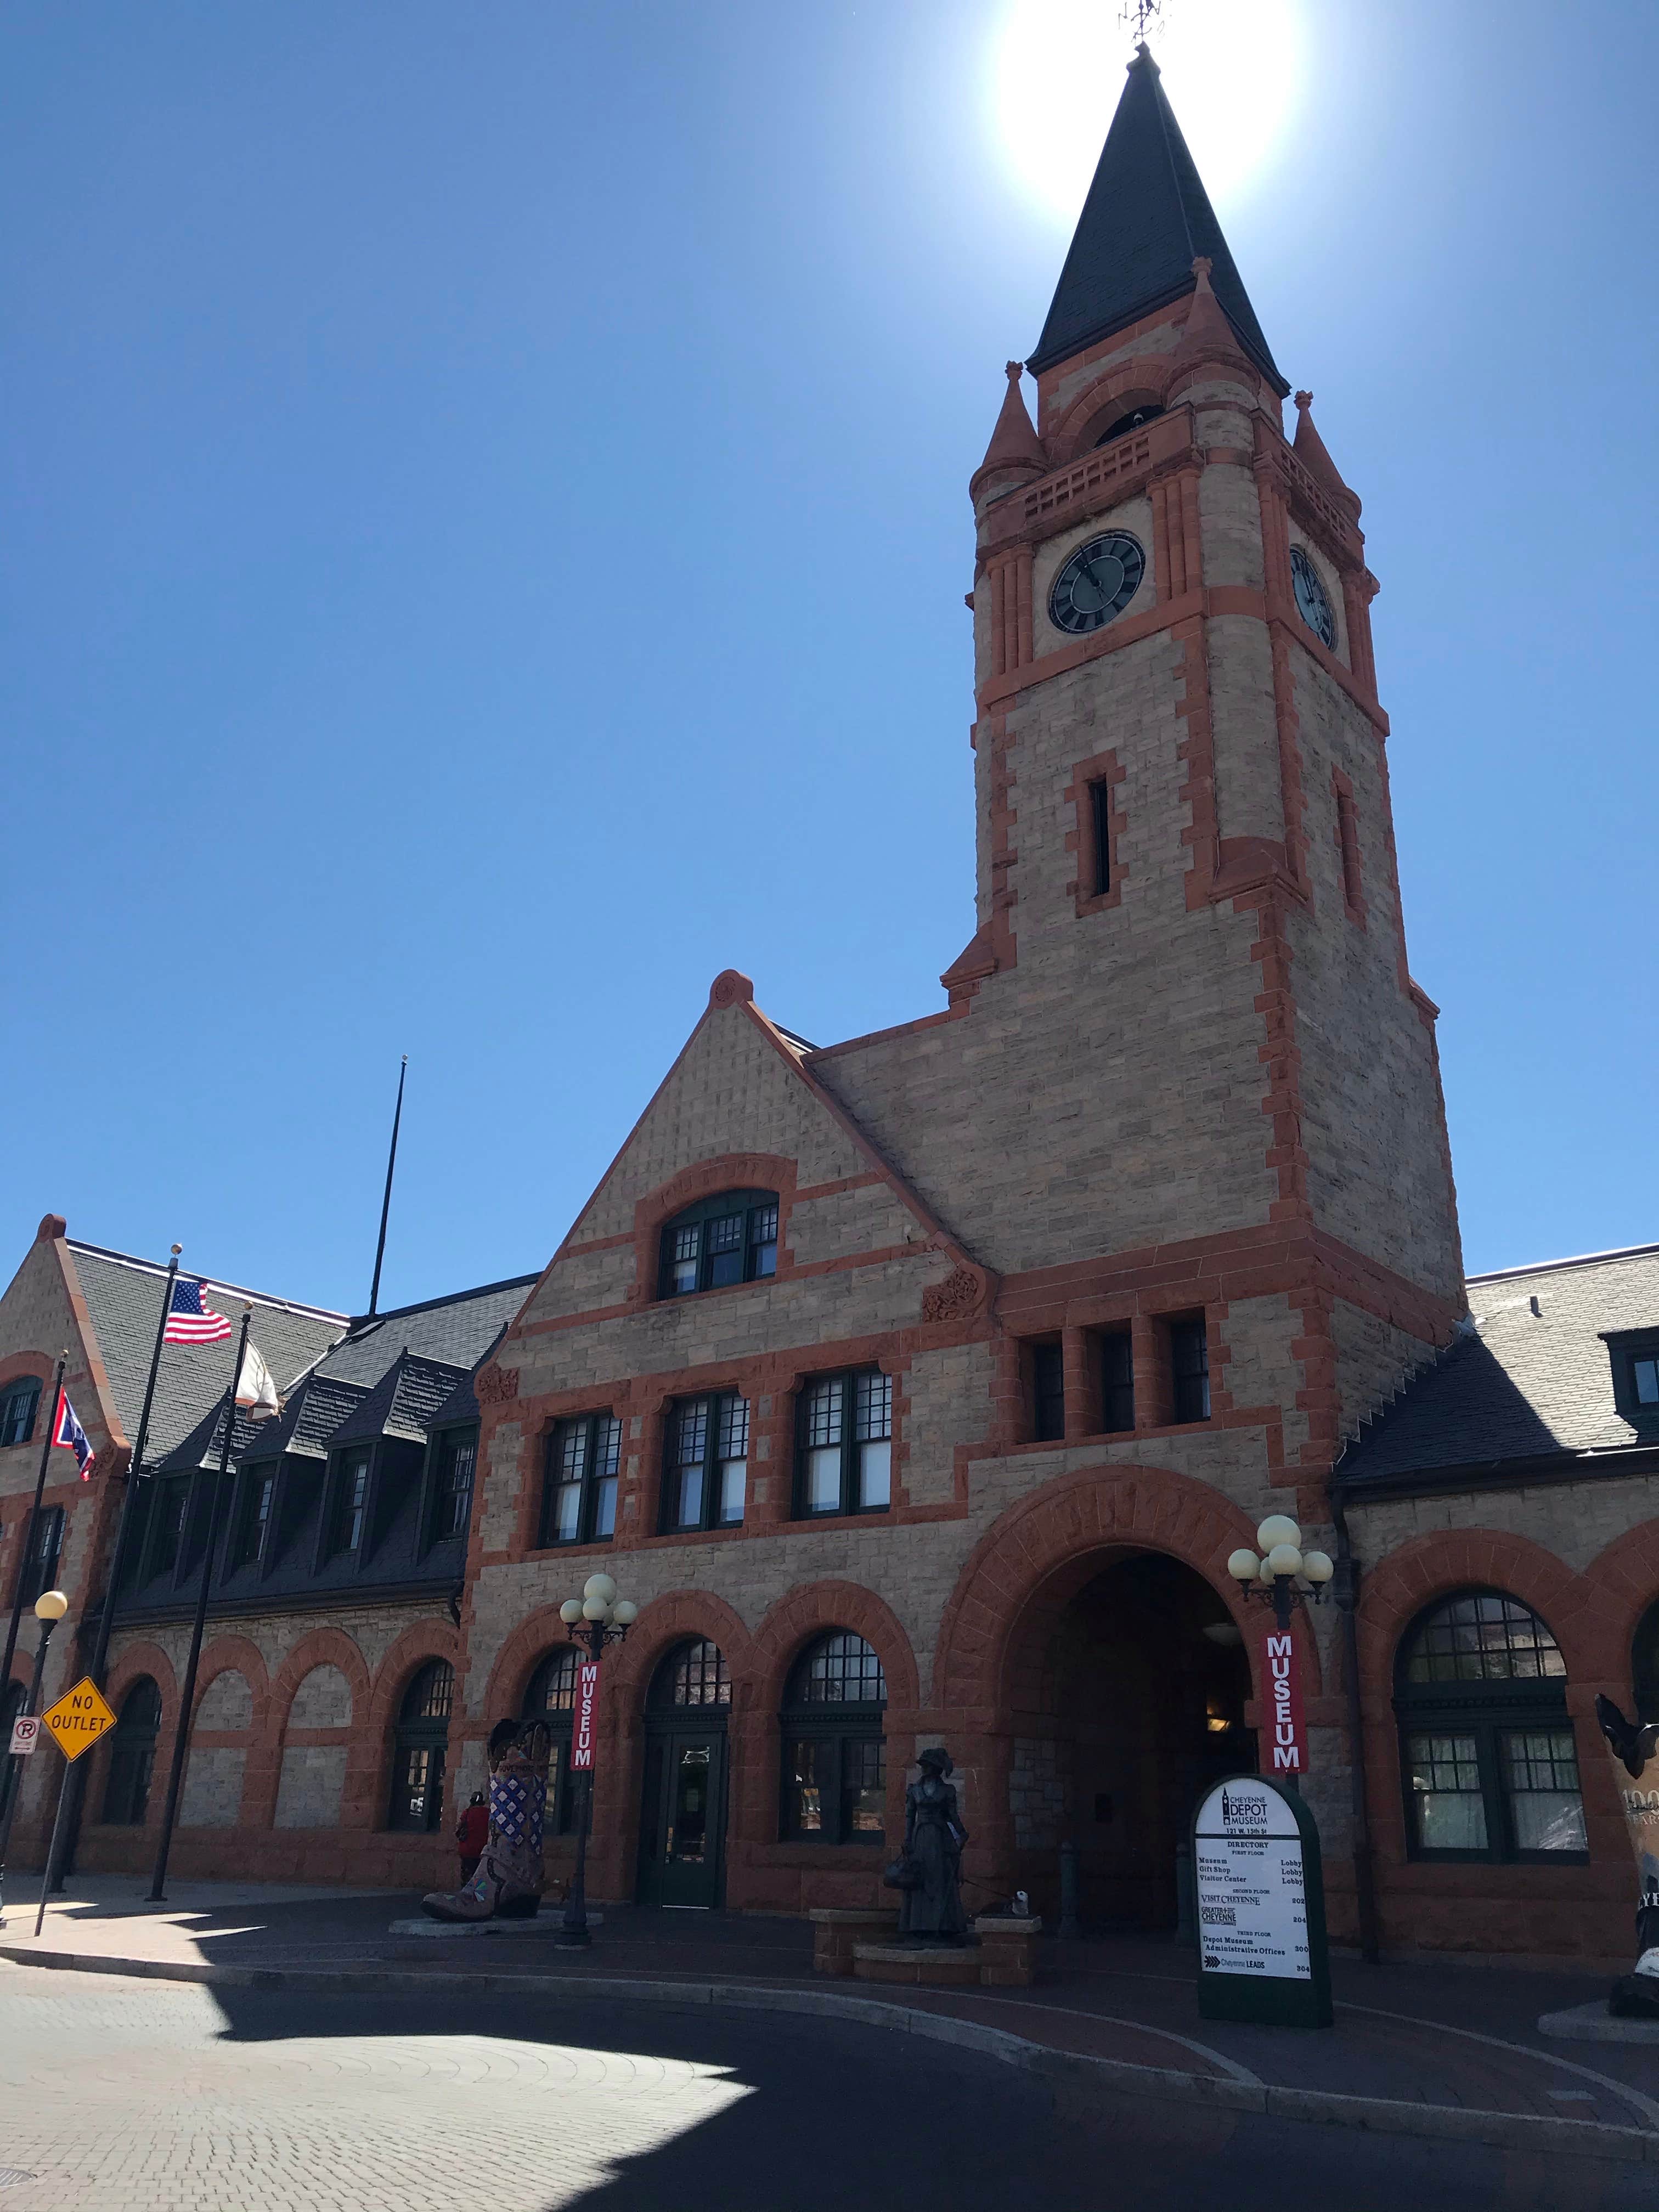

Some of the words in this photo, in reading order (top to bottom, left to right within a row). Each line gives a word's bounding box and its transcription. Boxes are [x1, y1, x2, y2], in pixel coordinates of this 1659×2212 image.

[72, 1695, 93, 1709] NO
[1267, 1635, 1300, 1768] MUSEUM
[575, 1666, 597, 1766] MUSEUM
[52, 1715, 106, 1731] OUTLET
[1230, 1804, 1267, 1815] DEPOT
[1627, 1812, 1659, 1825] YEAR
[1281, 1859, 1302, 1867] Lobby
[1282, 1869, 1302, 1877] Lobby
[1221, 1895, 1260, 1905] CHEYENNE
[1201, 1913, 1236, 1921] CHEYENNE
[1203, 1936, 1223, 1944] Depot
[1206, 1945, 1258, 1953] Administrative
